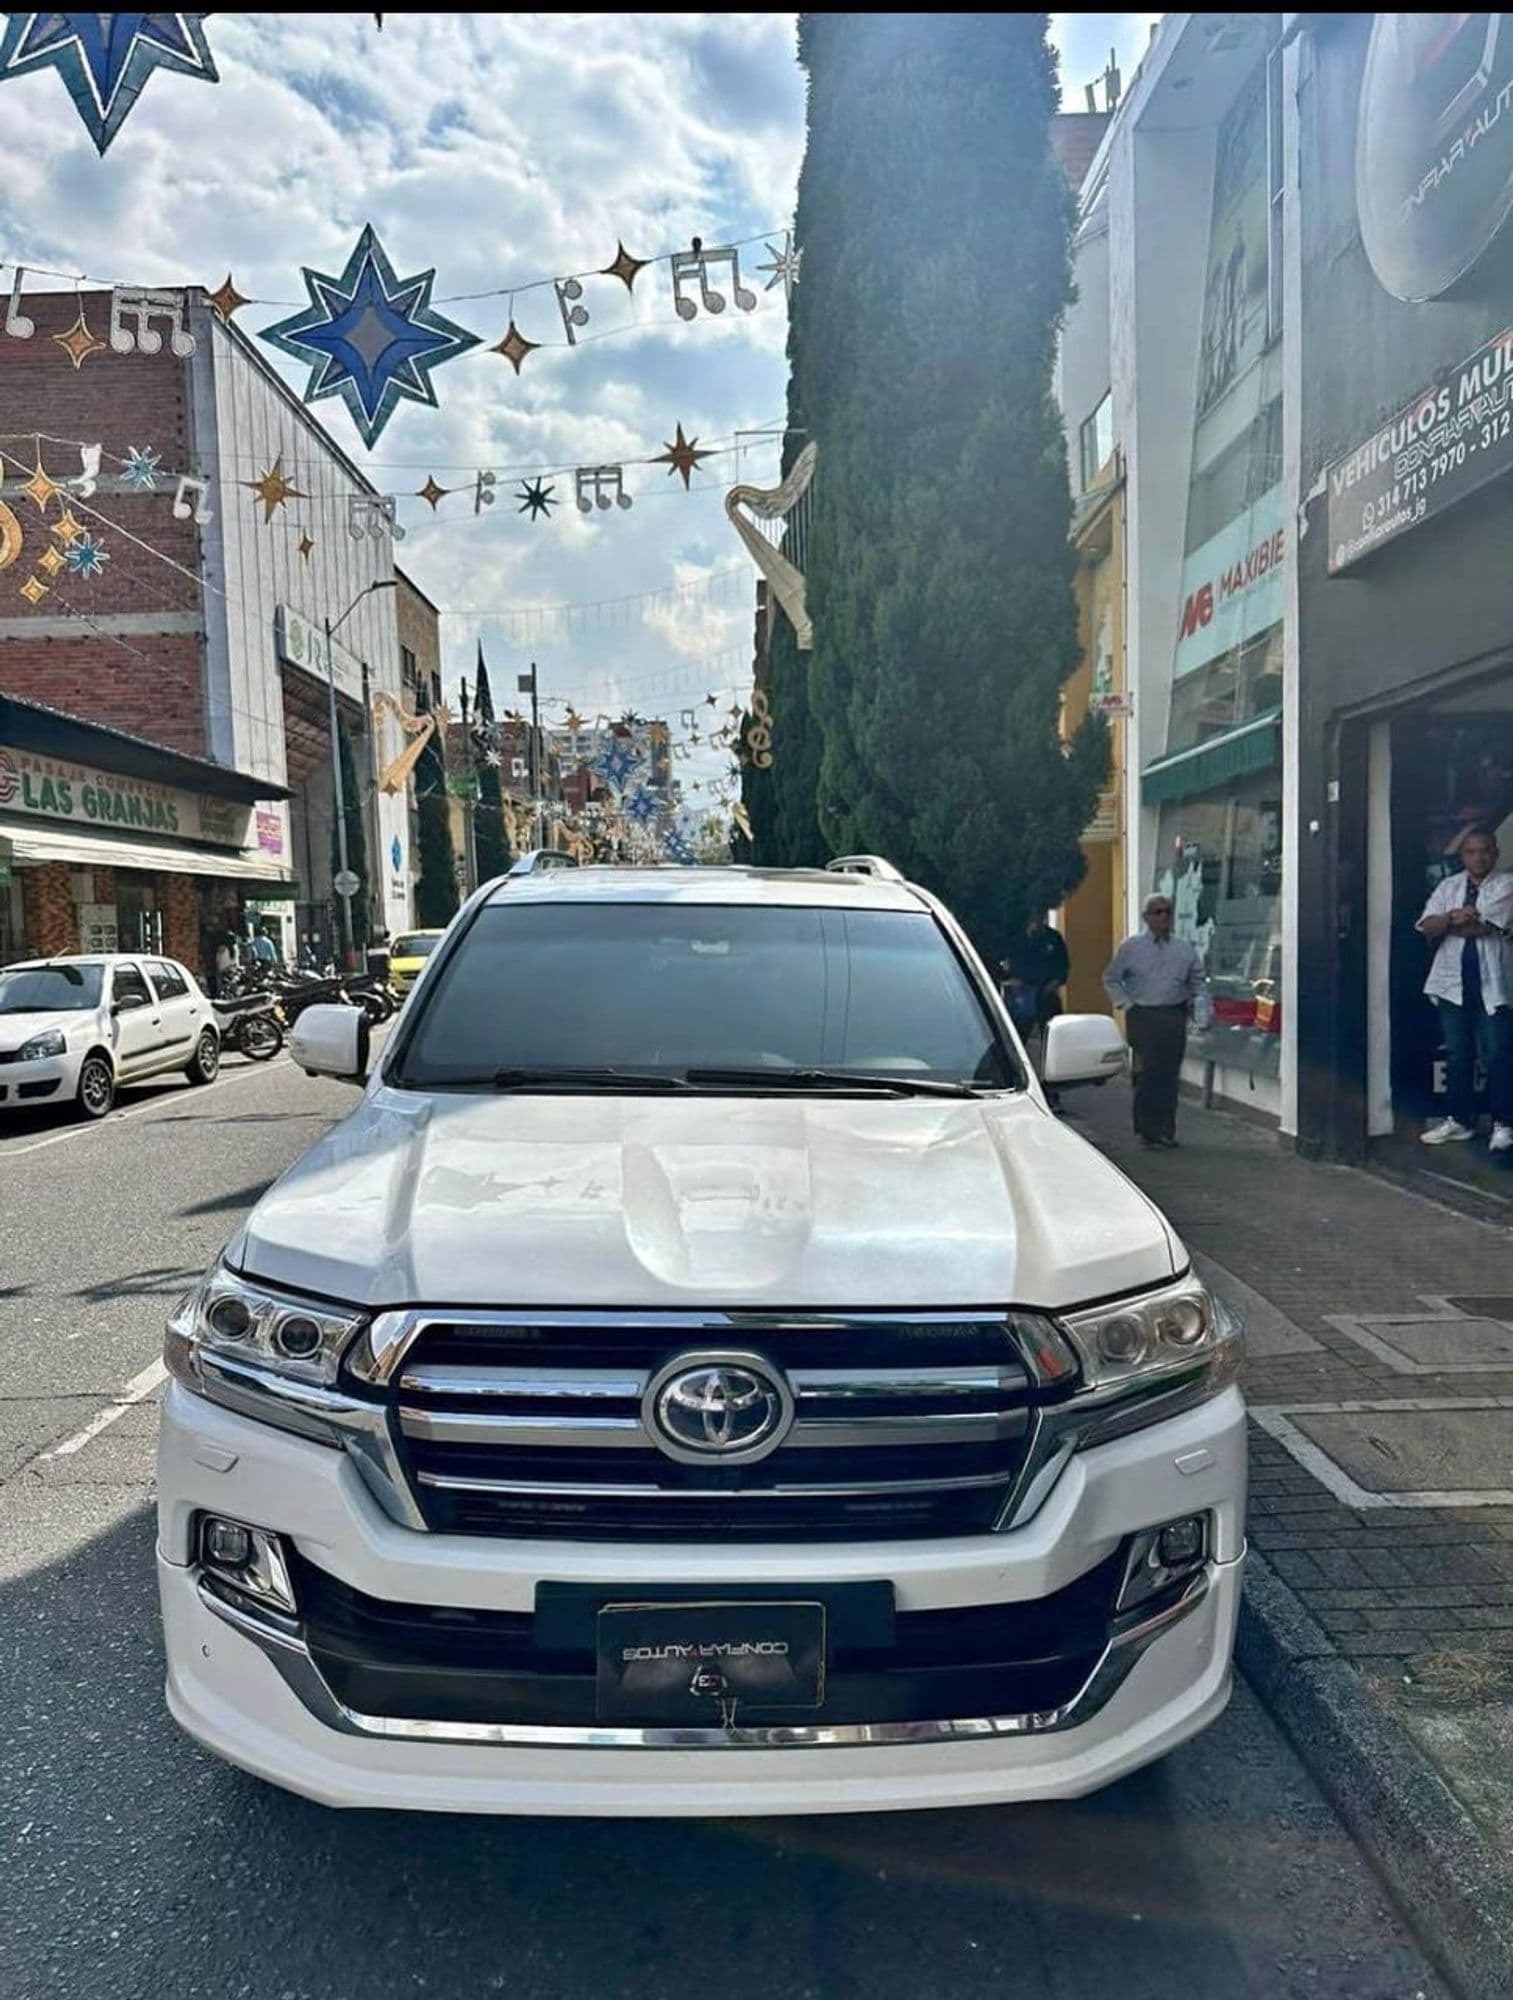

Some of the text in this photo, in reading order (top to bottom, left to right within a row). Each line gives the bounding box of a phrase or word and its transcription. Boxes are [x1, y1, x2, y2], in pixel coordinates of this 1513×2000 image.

[1332, 387, 1450, 496] VEHICULOS
[1377, 486, 1399, 516] 314
[1403, 467, 1427, 500] 713
[1431, 447, 1465, 482] 7970
[1481, 411, 1510, 448] 312
[21, 771, 73, 814] LAS
[81, 784, 178, 833] GRANJAS
[622, 1641, 789, 1660] CONFIAR AUTOS
